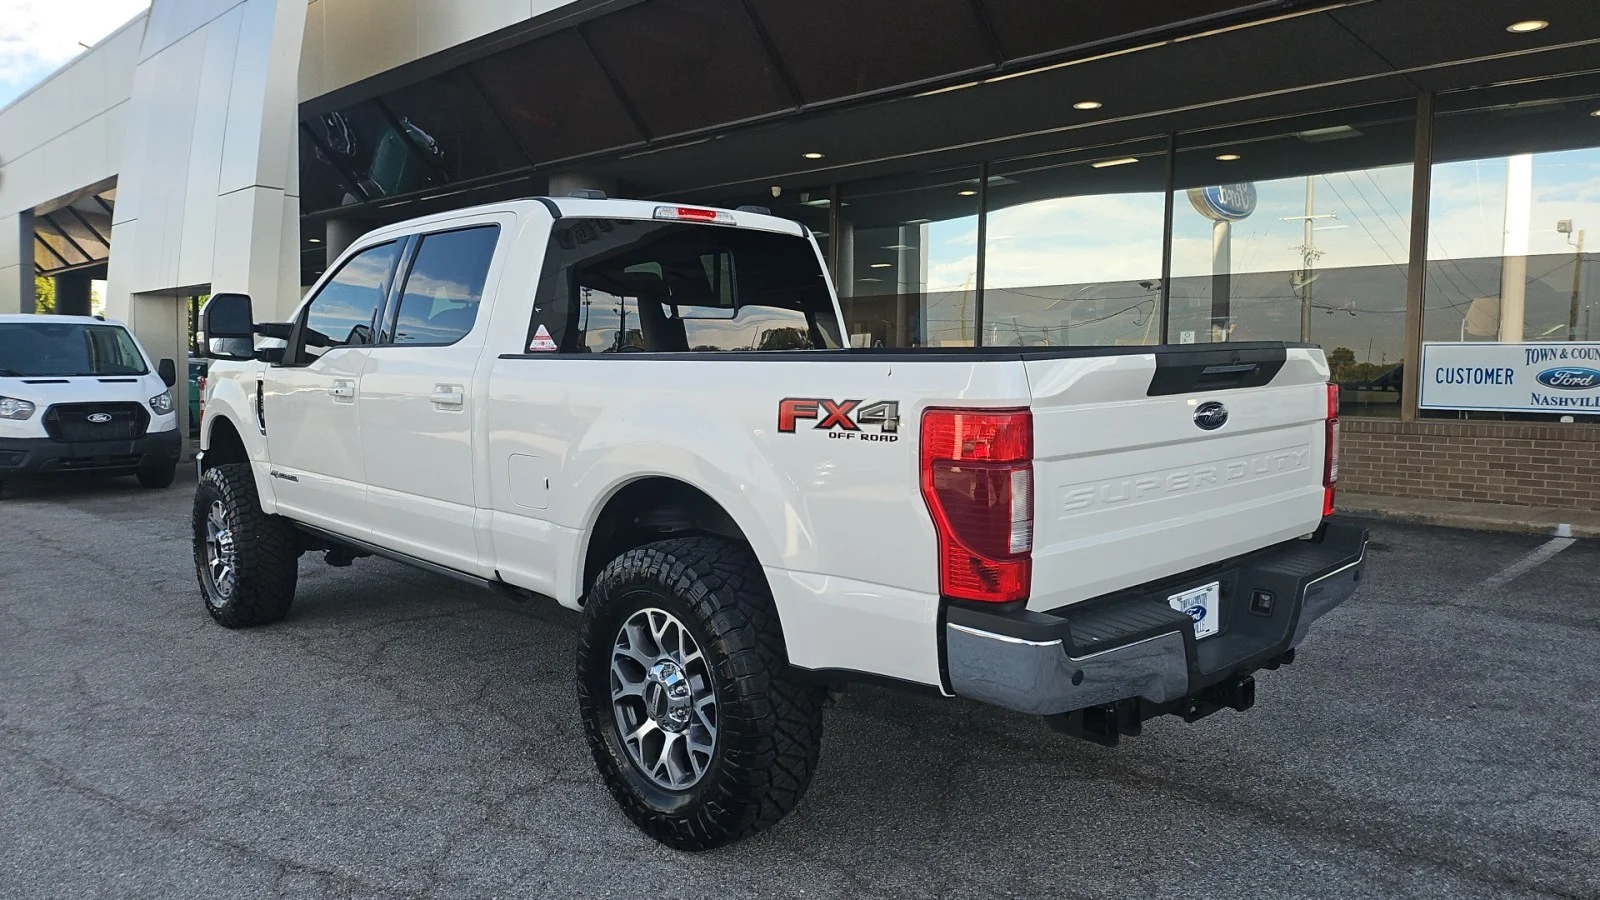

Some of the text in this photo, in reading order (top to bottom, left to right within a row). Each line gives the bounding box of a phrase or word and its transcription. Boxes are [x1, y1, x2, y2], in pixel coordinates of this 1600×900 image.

[1525, 348, 1557, 366] TOWN
[1560, 348, 1568, 360] &
[1436, 367, 1514, 385] CUSTOMER
[1550, 370, 1594, 386] Ford
[778, 397, 900, 434] FX4
[829, 432, 898, 442] OFF ROAD
[1064, 449, 1308, 512] SUPER DUTY
